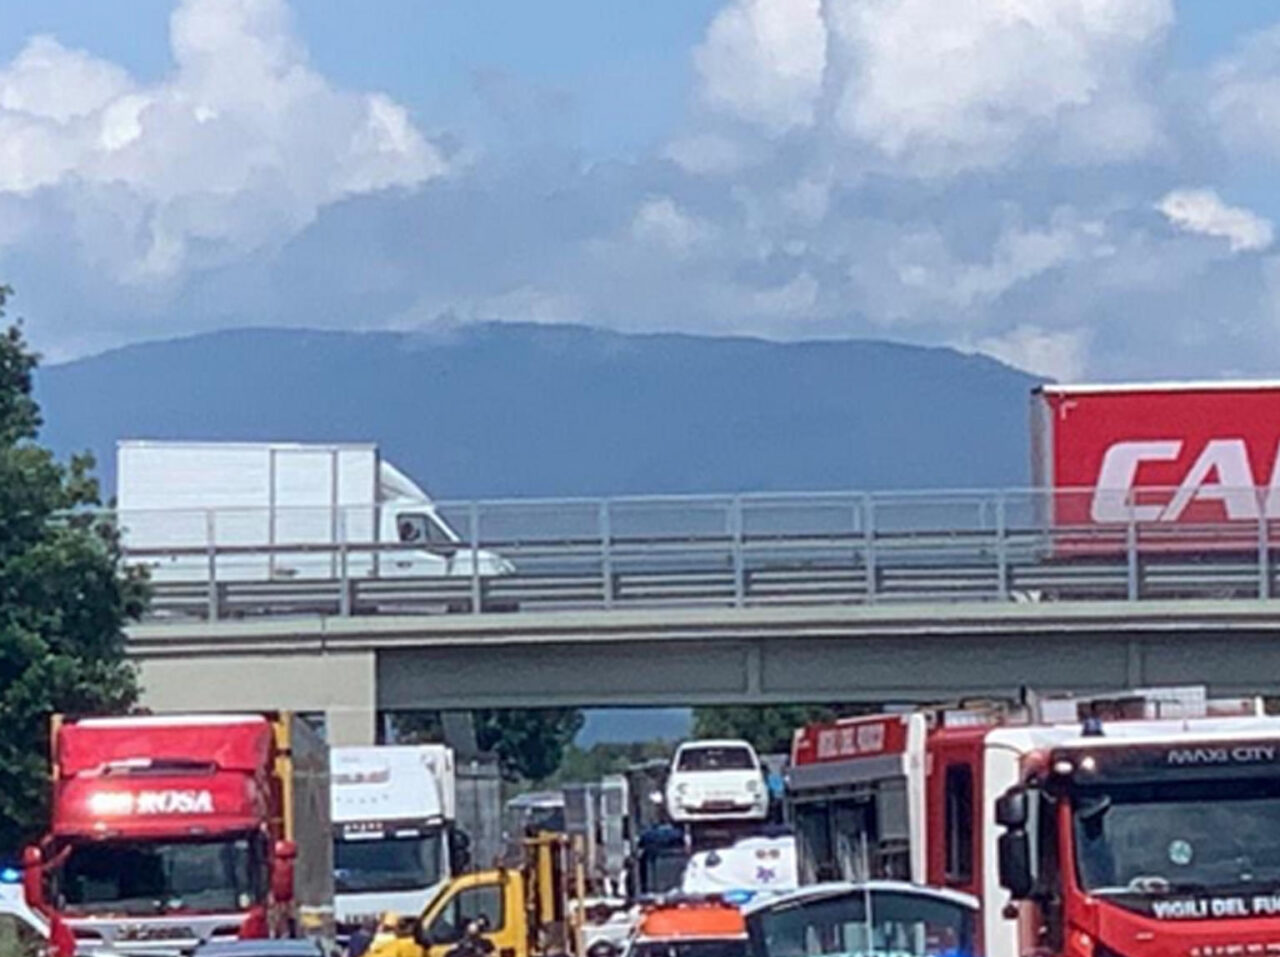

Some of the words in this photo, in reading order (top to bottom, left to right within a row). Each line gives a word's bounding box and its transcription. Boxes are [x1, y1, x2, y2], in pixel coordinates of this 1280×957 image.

[1167, 748, 1228, 764] MAXI
[136, 789, 215, 814] ROSA
[1152, 900, 1208, 919] VIGILI
[1211, 898, 1249, 916] DEL
